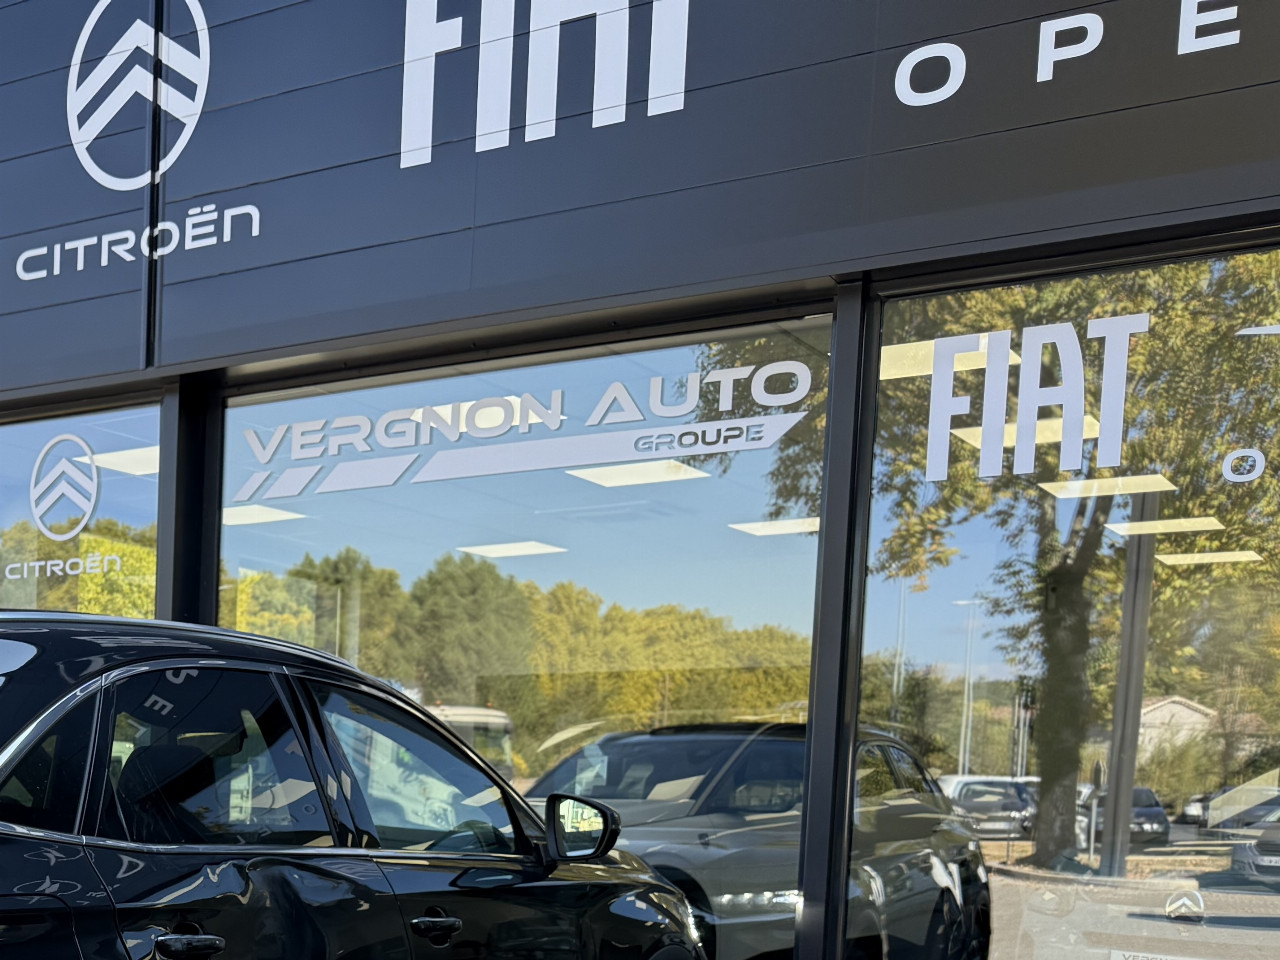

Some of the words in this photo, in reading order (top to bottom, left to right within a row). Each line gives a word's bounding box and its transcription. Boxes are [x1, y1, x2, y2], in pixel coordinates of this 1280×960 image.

[243, 389, 563, 465] VERGNON
[585, 360, 812, 428] AUTO
[633, 422, 766, 454] GROUPE
[924, 312, 1150, 482] FIAT
